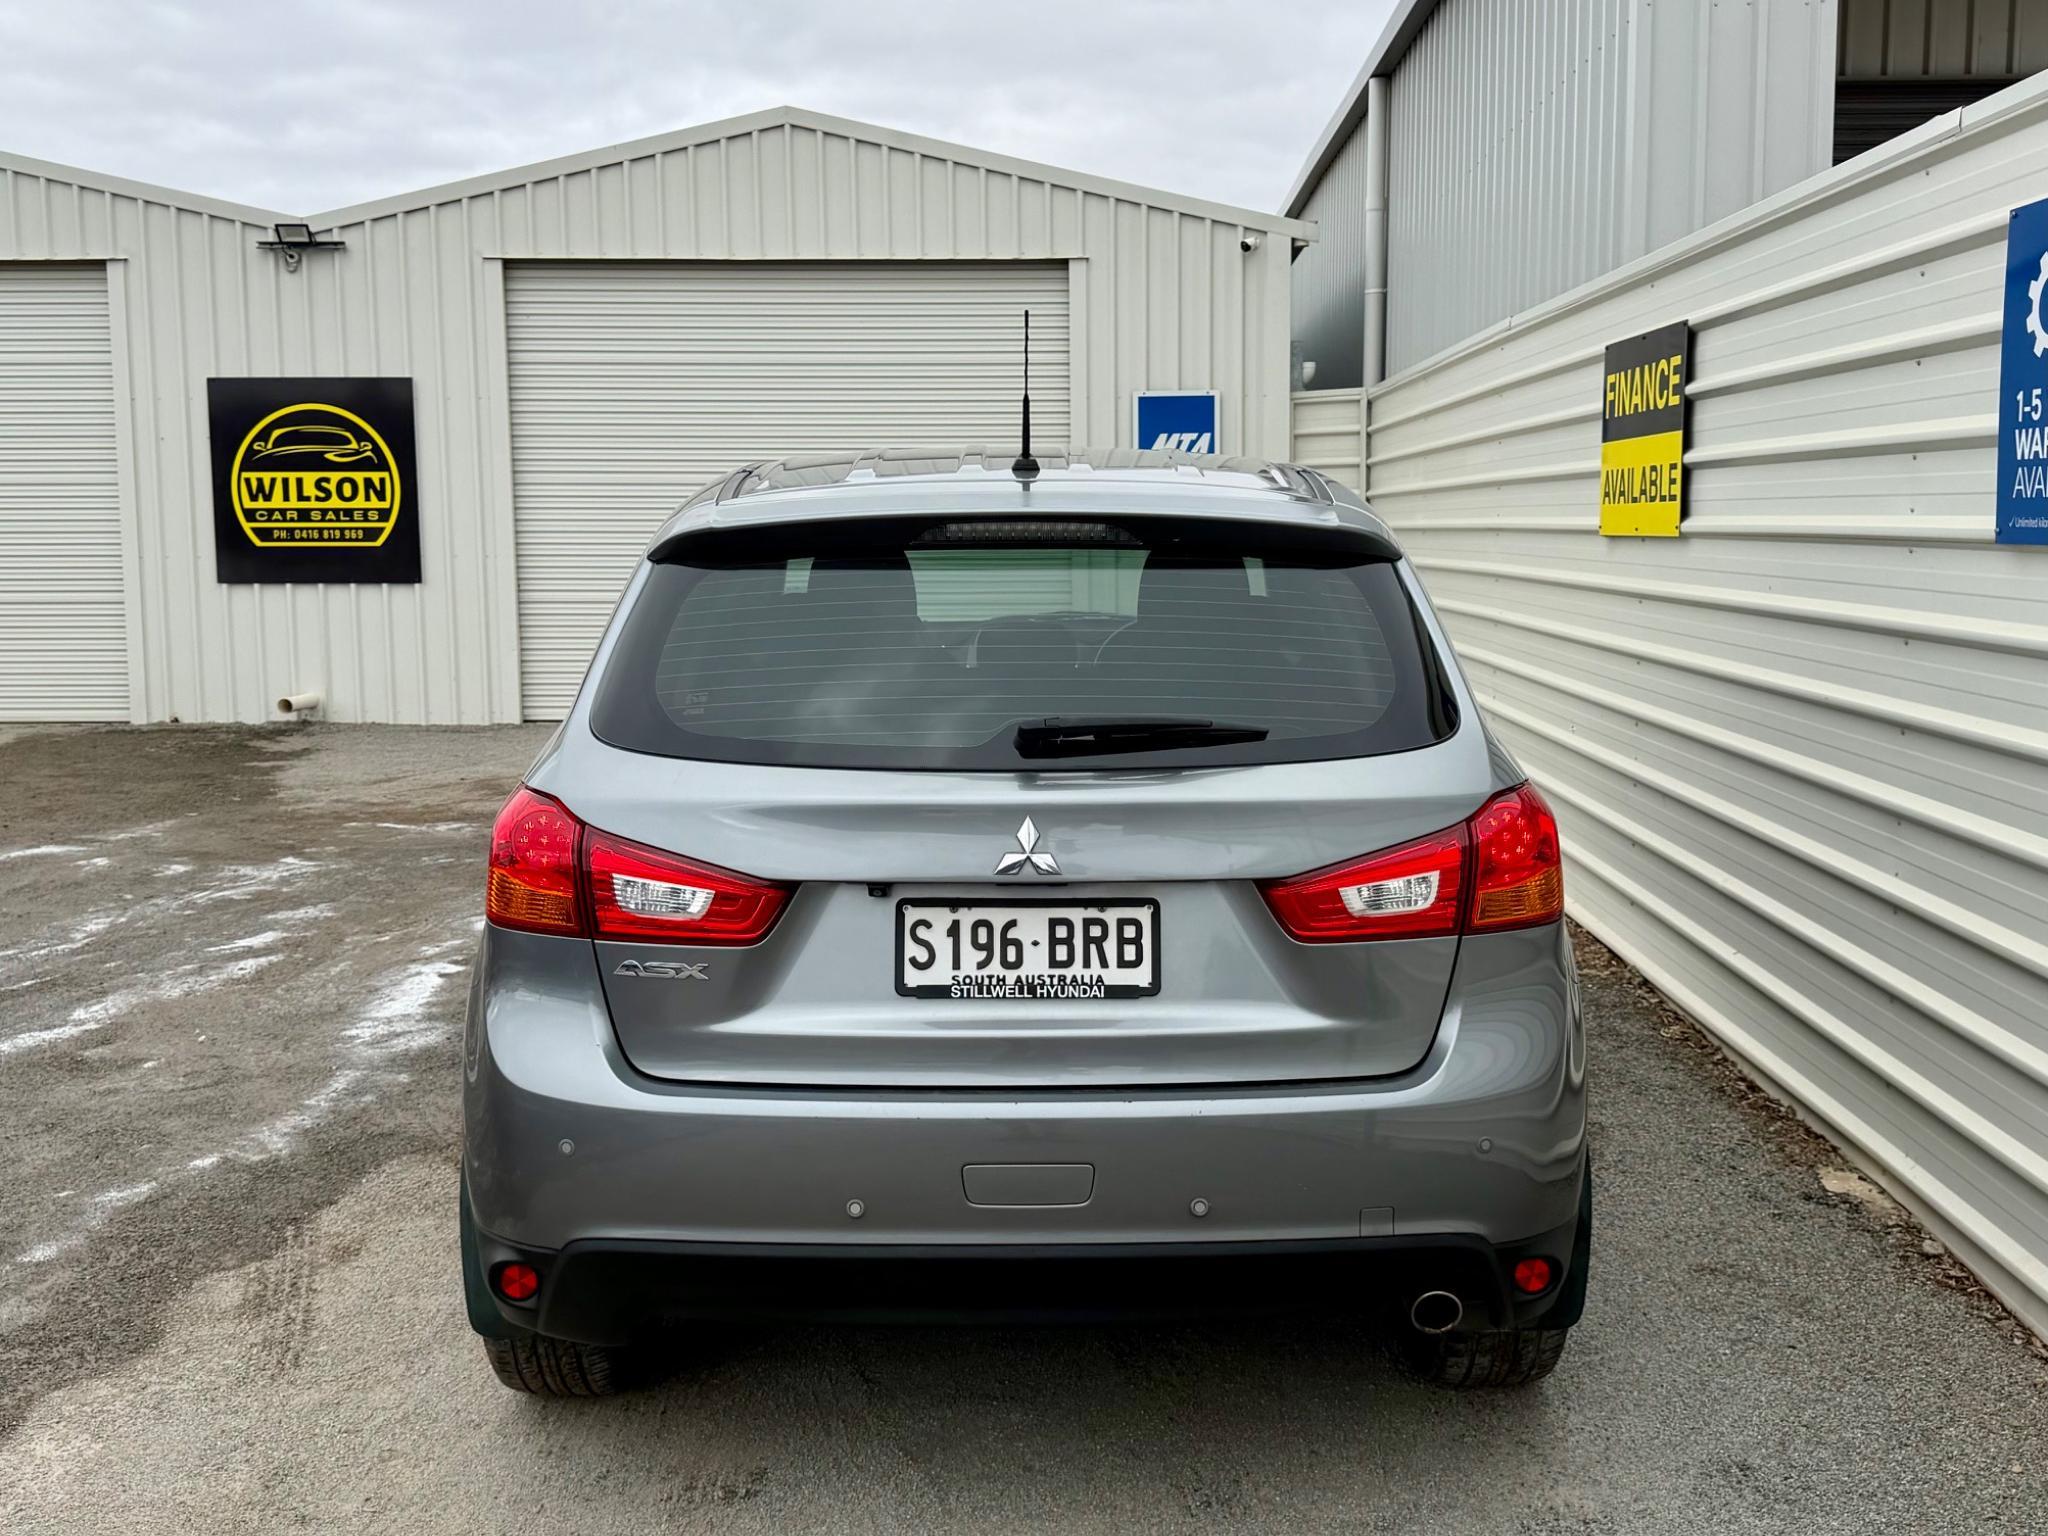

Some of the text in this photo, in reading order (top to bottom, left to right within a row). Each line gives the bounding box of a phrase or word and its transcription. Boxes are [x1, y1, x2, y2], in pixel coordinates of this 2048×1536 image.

[1605, 354, 1682, 419] FINANCE
[2016, 387, 2042, 422] 1-5
[1151, 432, 1212, 454] MTA
[243, 476, 387, 503] WILSON
[1602, 462, 1678, 504] AVAILABLE
[255, 510, 380, 521] CAR SALES
[273, 529, 364, 539] PH: 0416 819 969
[613, 959, 709, 980] ASX
[951, 974, 1105, 985] SOUTH AUSTRALIA
[950, 985, 1105, 998] STILLWELL HYUNDAI
